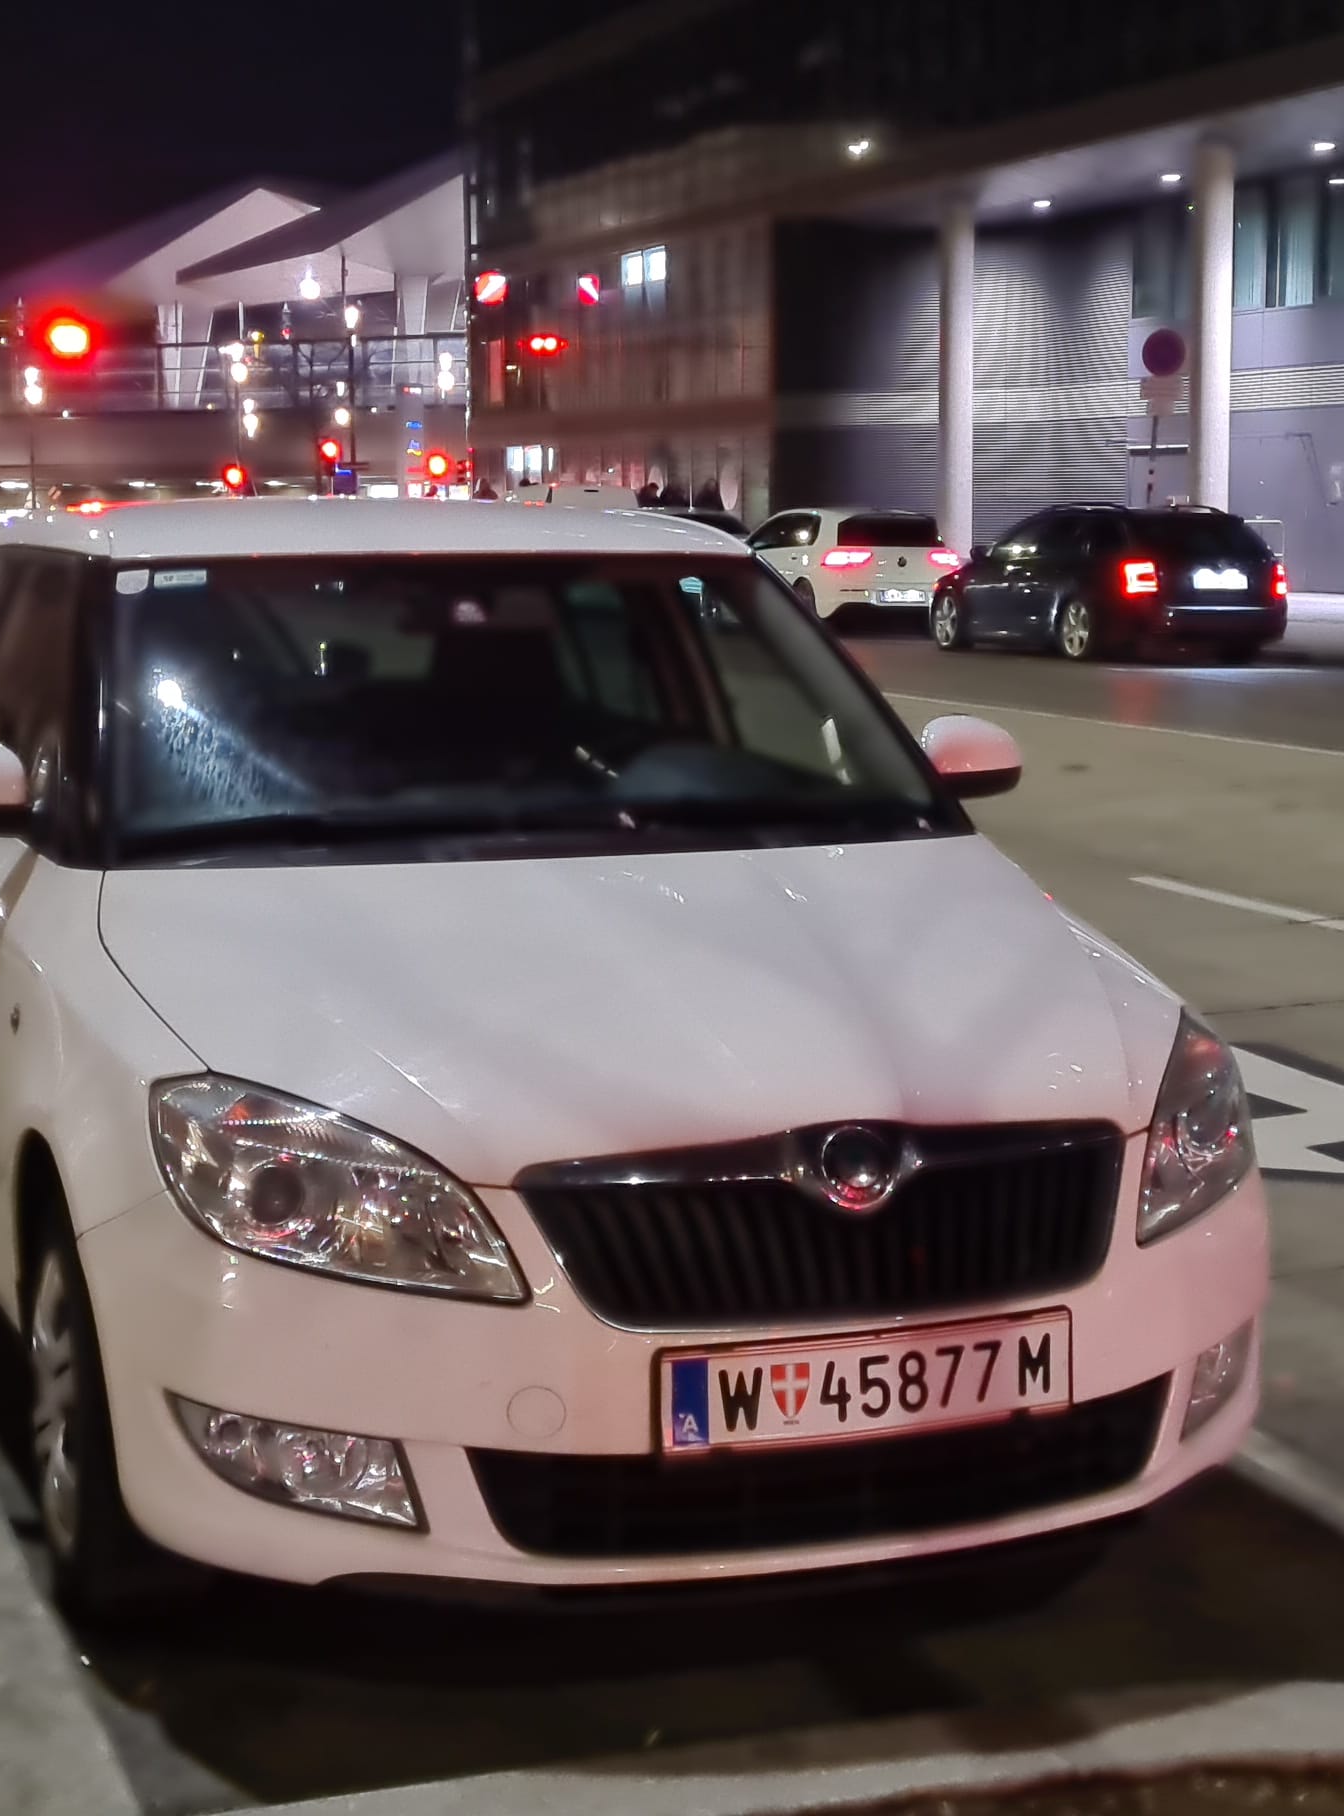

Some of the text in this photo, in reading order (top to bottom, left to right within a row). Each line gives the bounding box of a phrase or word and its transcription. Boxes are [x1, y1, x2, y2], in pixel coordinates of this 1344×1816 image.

[718, 1332, 1052, 1432] W 45877 M
